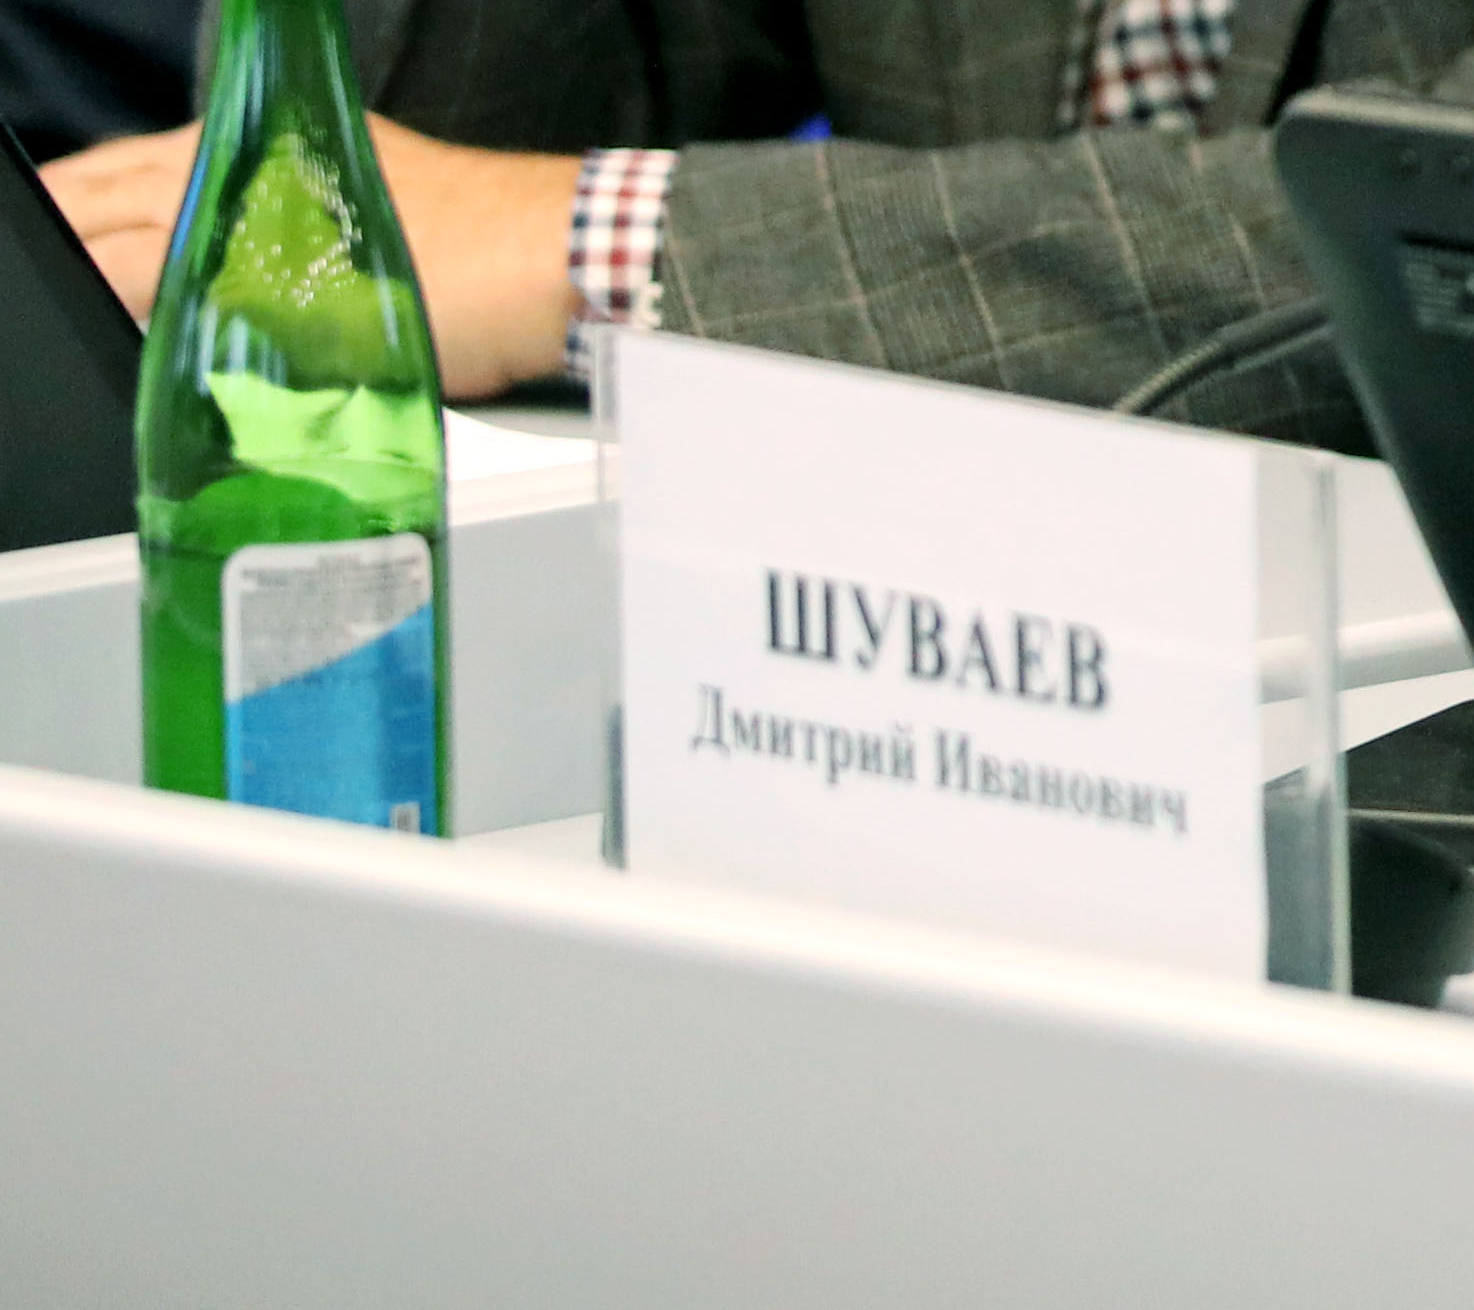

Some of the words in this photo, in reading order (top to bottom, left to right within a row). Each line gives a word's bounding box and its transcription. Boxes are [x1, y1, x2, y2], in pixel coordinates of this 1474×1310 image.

[763, 566, 1110, 711] ШУВАЕВ
[691, 683, 918, 786] Дмитрий
[935, 726, 1190, 836] Иванович
